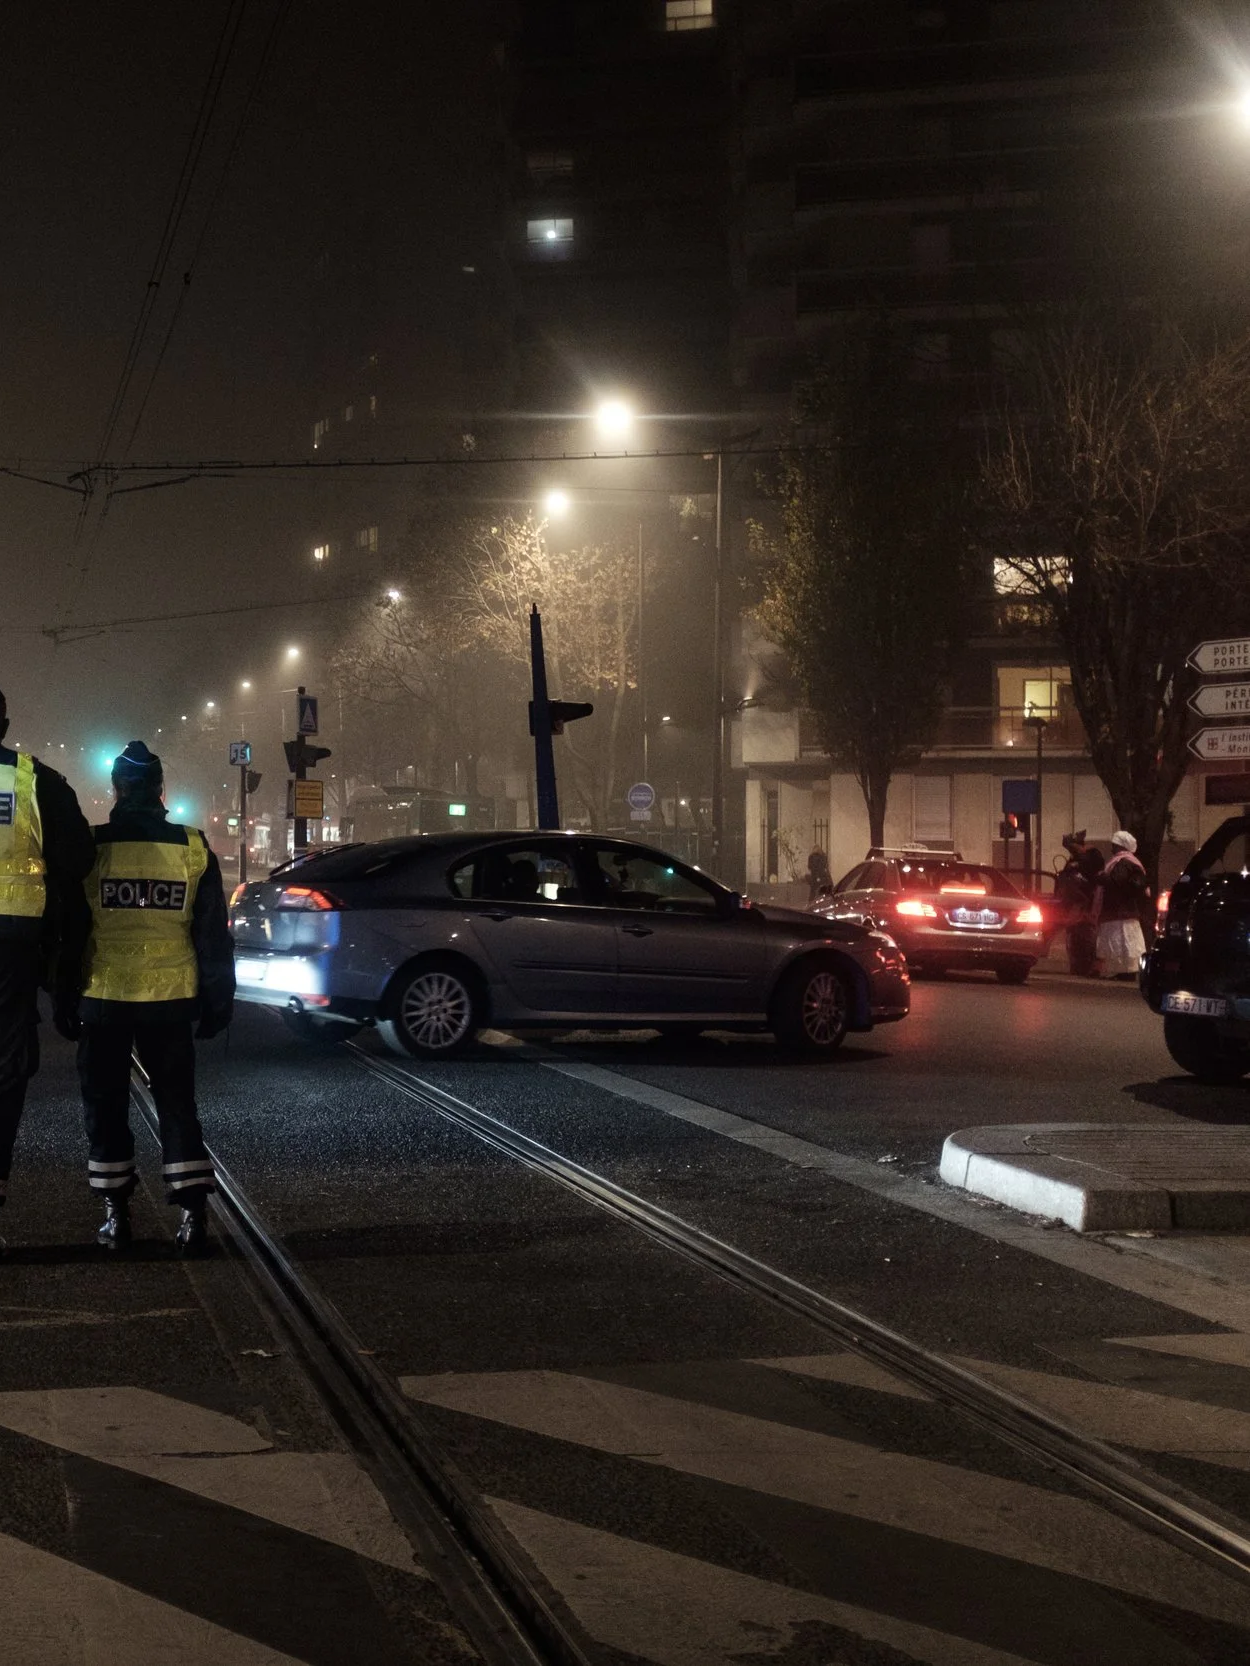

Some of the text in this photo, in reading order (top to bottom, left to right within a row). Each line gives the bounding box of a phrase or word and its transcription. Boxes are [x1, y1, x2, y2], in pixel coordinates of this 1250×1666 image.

[1214, 644, 1249, 656] PORTE
[1214, 656, 1249, 668] PORTE
[103, 882, 185, 906] POLICE
